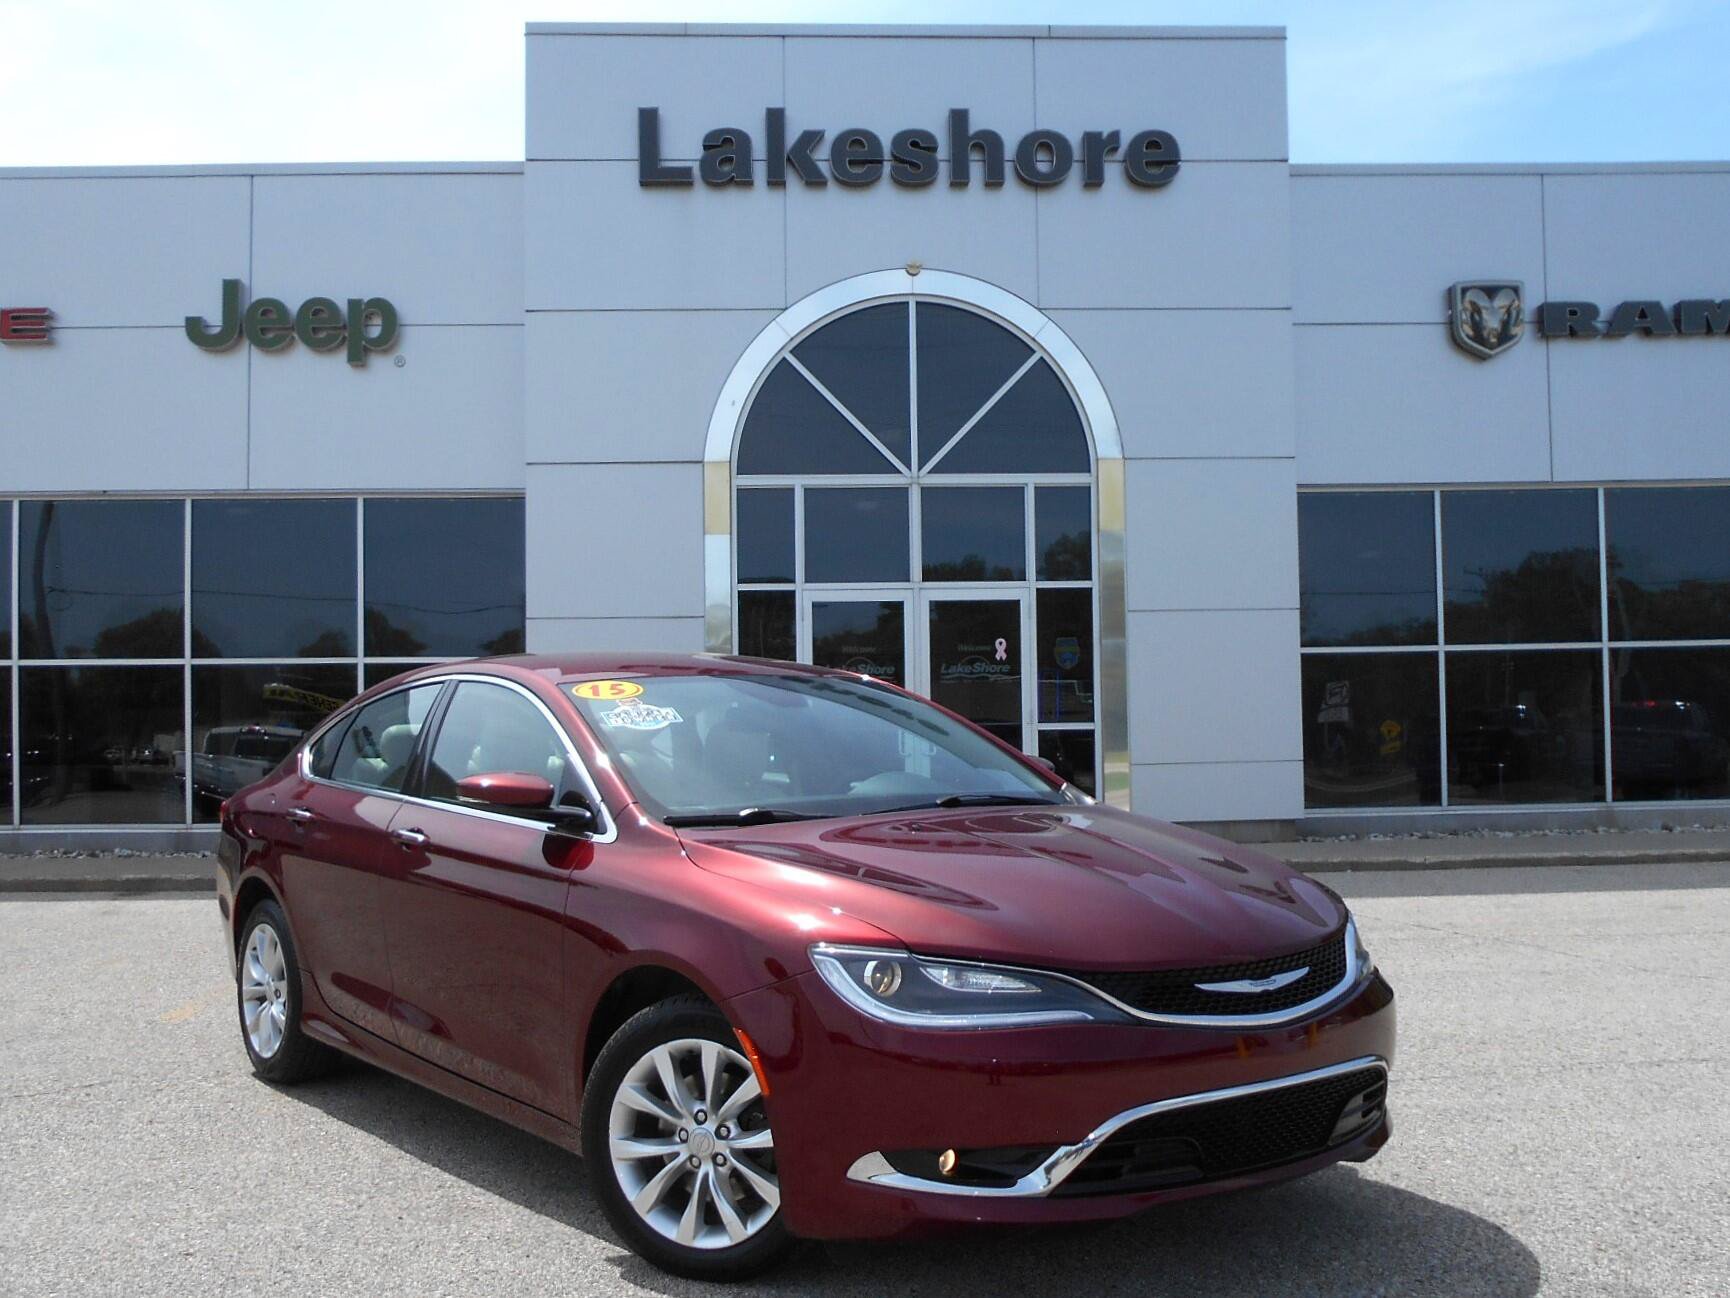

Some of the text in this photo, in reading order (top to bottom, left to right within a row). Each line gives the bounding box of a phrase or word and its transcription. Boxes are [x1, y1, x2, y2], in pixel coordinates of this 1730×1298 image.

[638, 107, 1181, 187] Lakeshore
[185, 279, 399, 367] Jeep
[588, 683, 625, 697] 15
